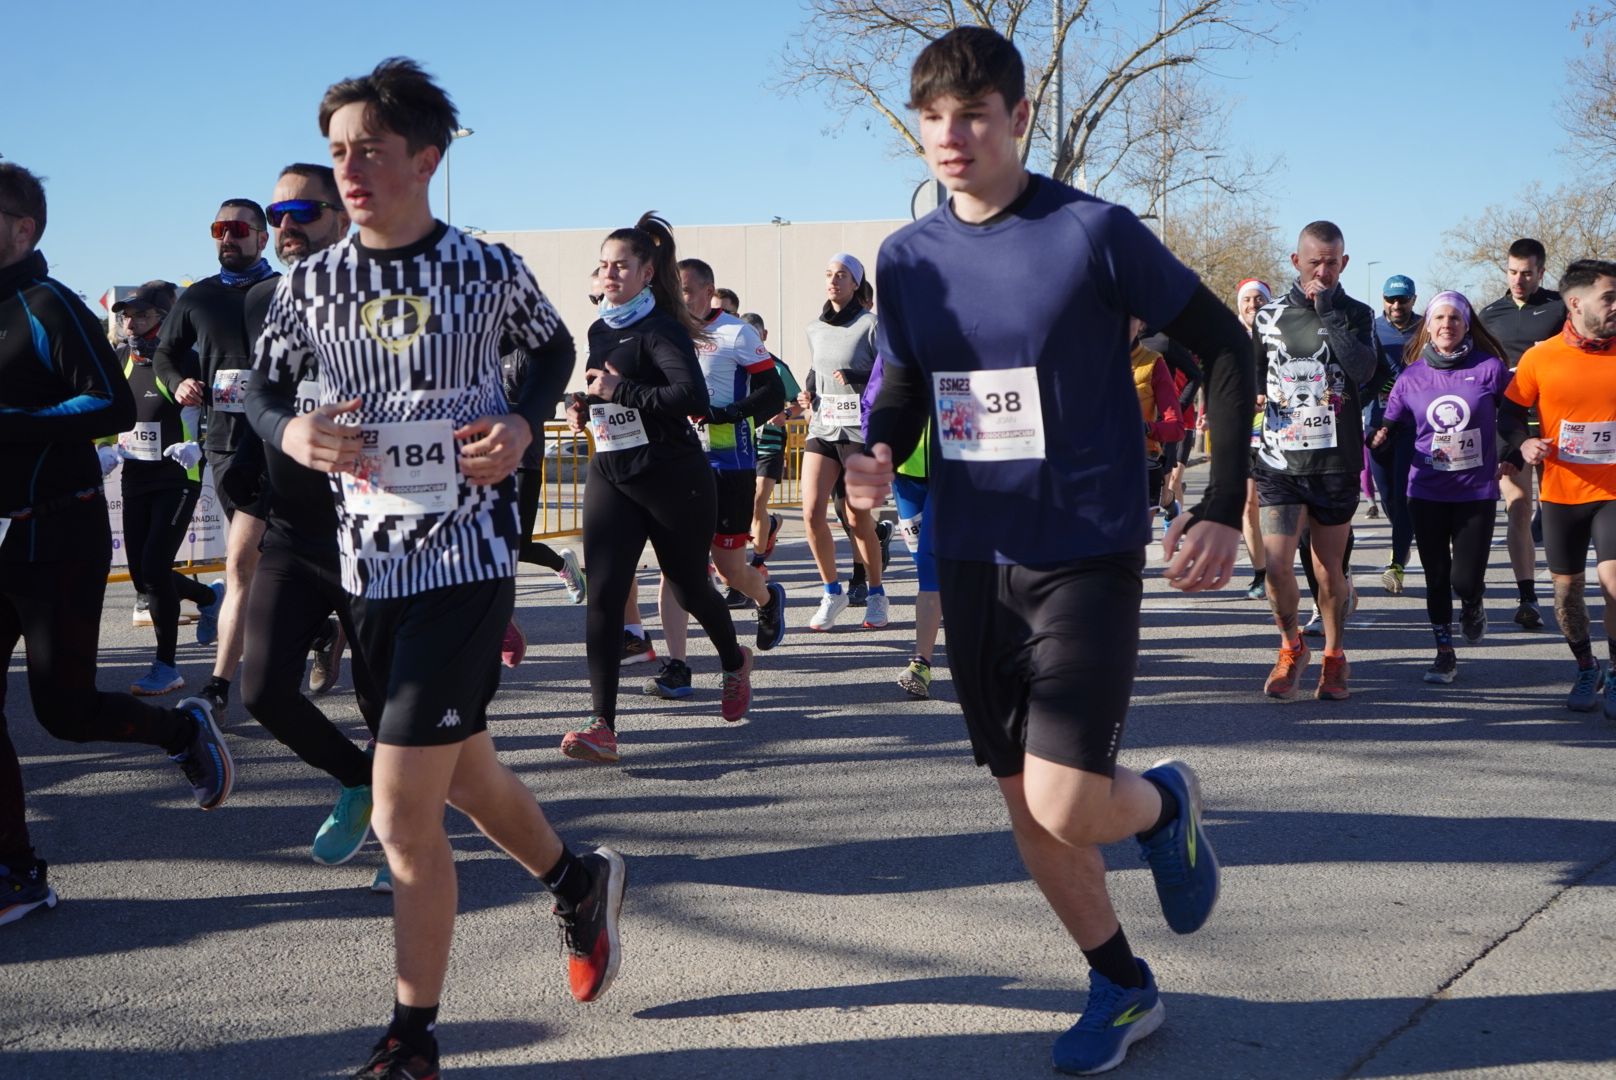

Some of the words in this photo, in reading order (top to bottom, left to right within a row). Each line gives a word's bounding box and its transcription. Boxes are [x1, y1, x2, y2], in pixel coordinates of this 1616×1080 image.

[939, 378, 970, 391] SSM23
[837, 402, 857, 410] 285
[986, 391, 1022, 414] 38
[608, 410, 636, 426] 408
[1303, 415, 1331, 428] 424
[133, 431, 157, 441] 163
[1592, 431, 1611, 442] 75
[1458, 439, 1474, 450] 74
[386, 442, 445, 468] 184
[904, 524, 921, 536] 18
